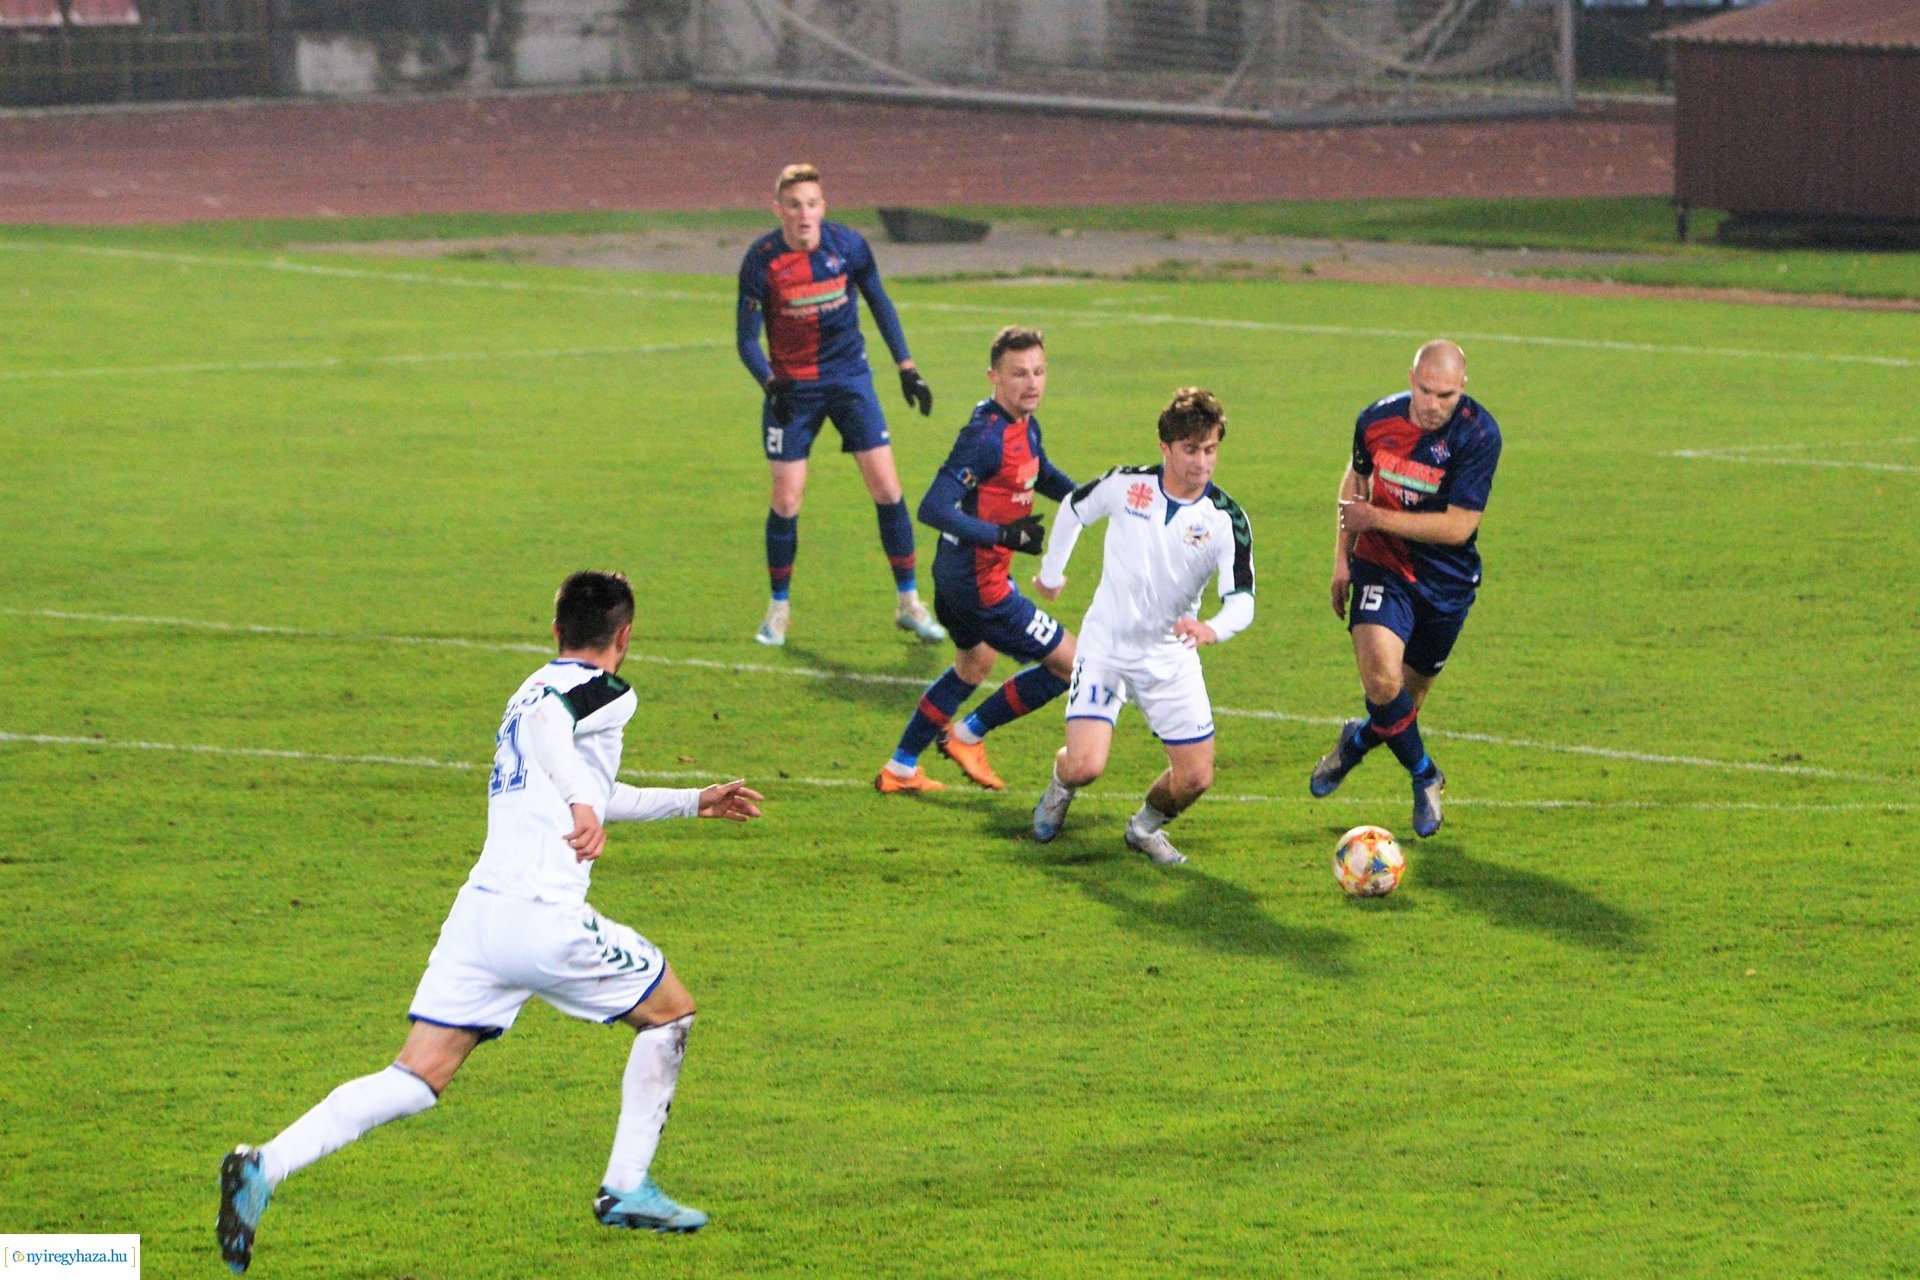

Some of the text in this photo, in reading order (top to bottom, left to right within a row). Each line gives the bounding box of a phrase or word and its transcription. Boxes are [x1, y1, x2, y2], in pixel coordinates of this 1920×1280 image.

[767, 427, 783, 454] 21
[1360, 585, 1384, 611] 15
[1026, 608, 1058, 646] 22
[1088, 684, 1114, 706] 17
